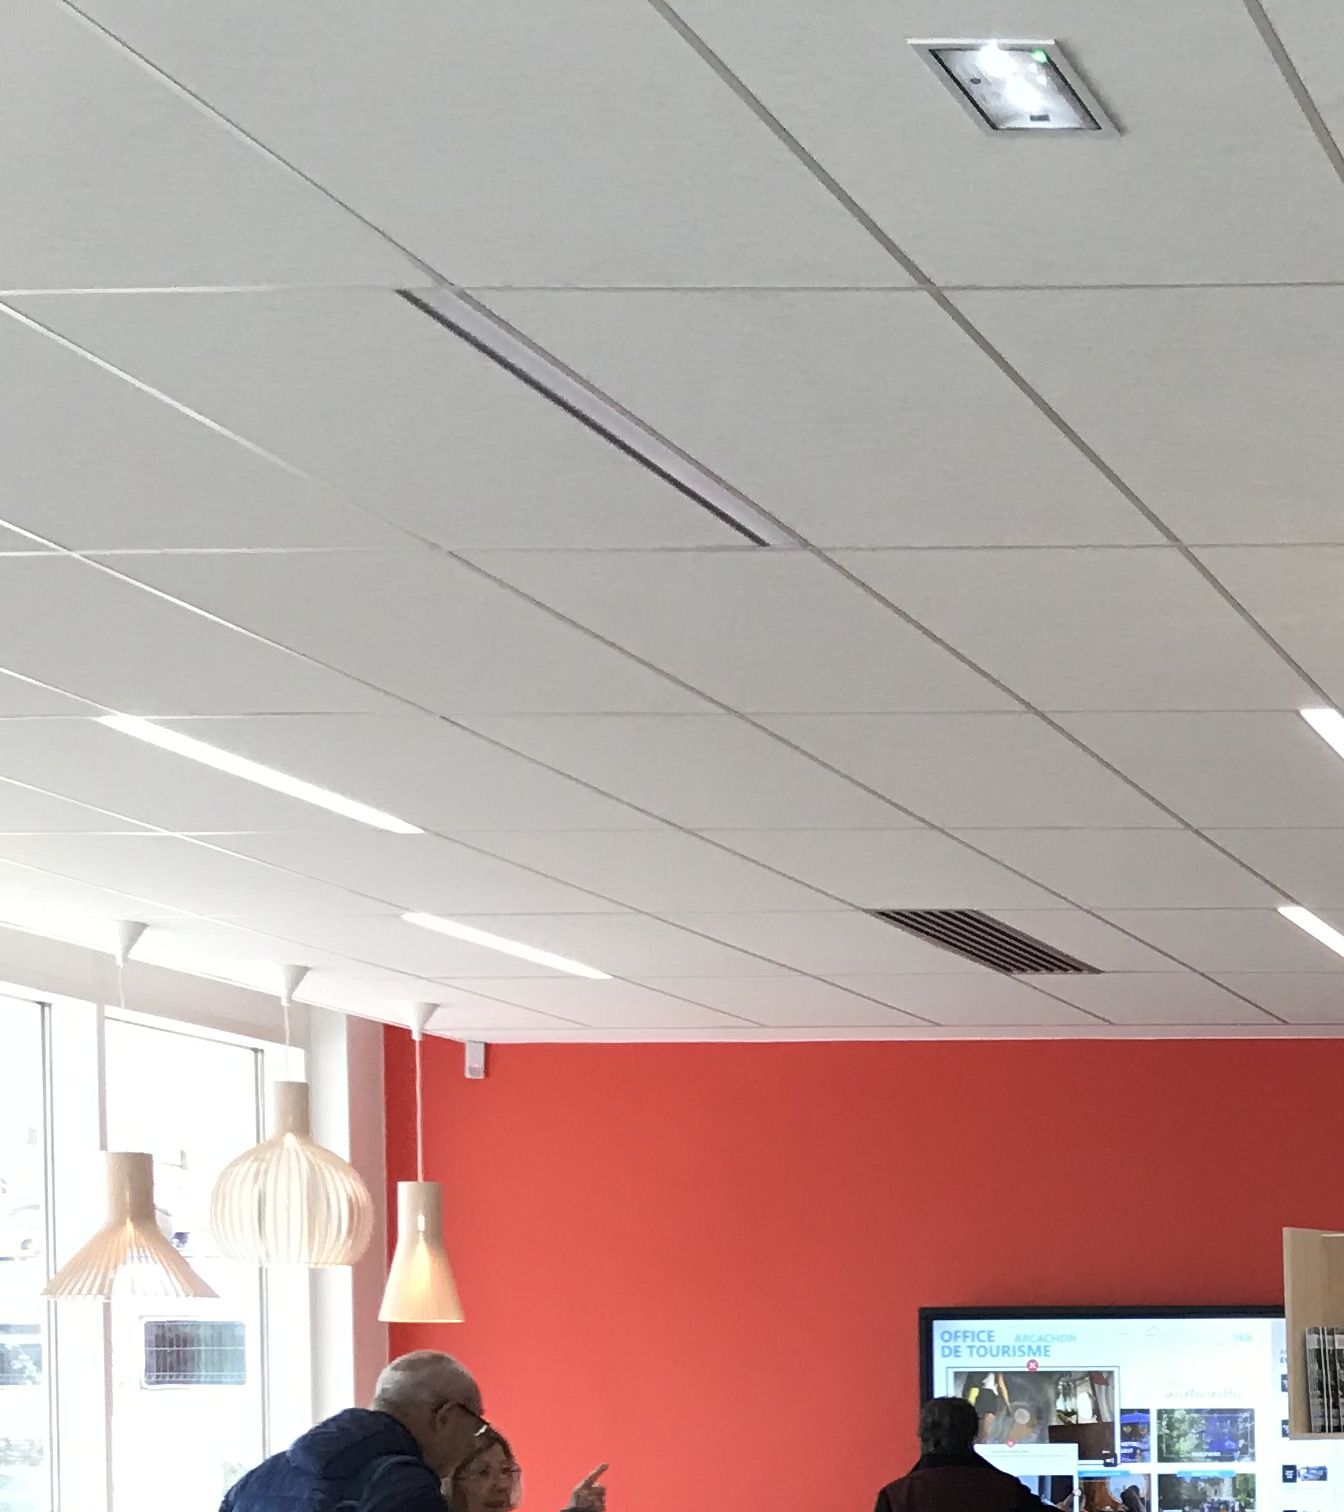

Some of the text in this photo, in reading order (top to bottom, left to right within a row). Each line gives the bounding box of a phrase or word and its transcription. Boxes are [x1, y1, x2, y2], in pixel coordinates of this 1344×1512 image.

[940, 1330, 995, 1343] OFFICE
[1014, 1334, 1077, 1343] ARCACHON
[941, 1345, 1051, 1358] DE TOURISME
